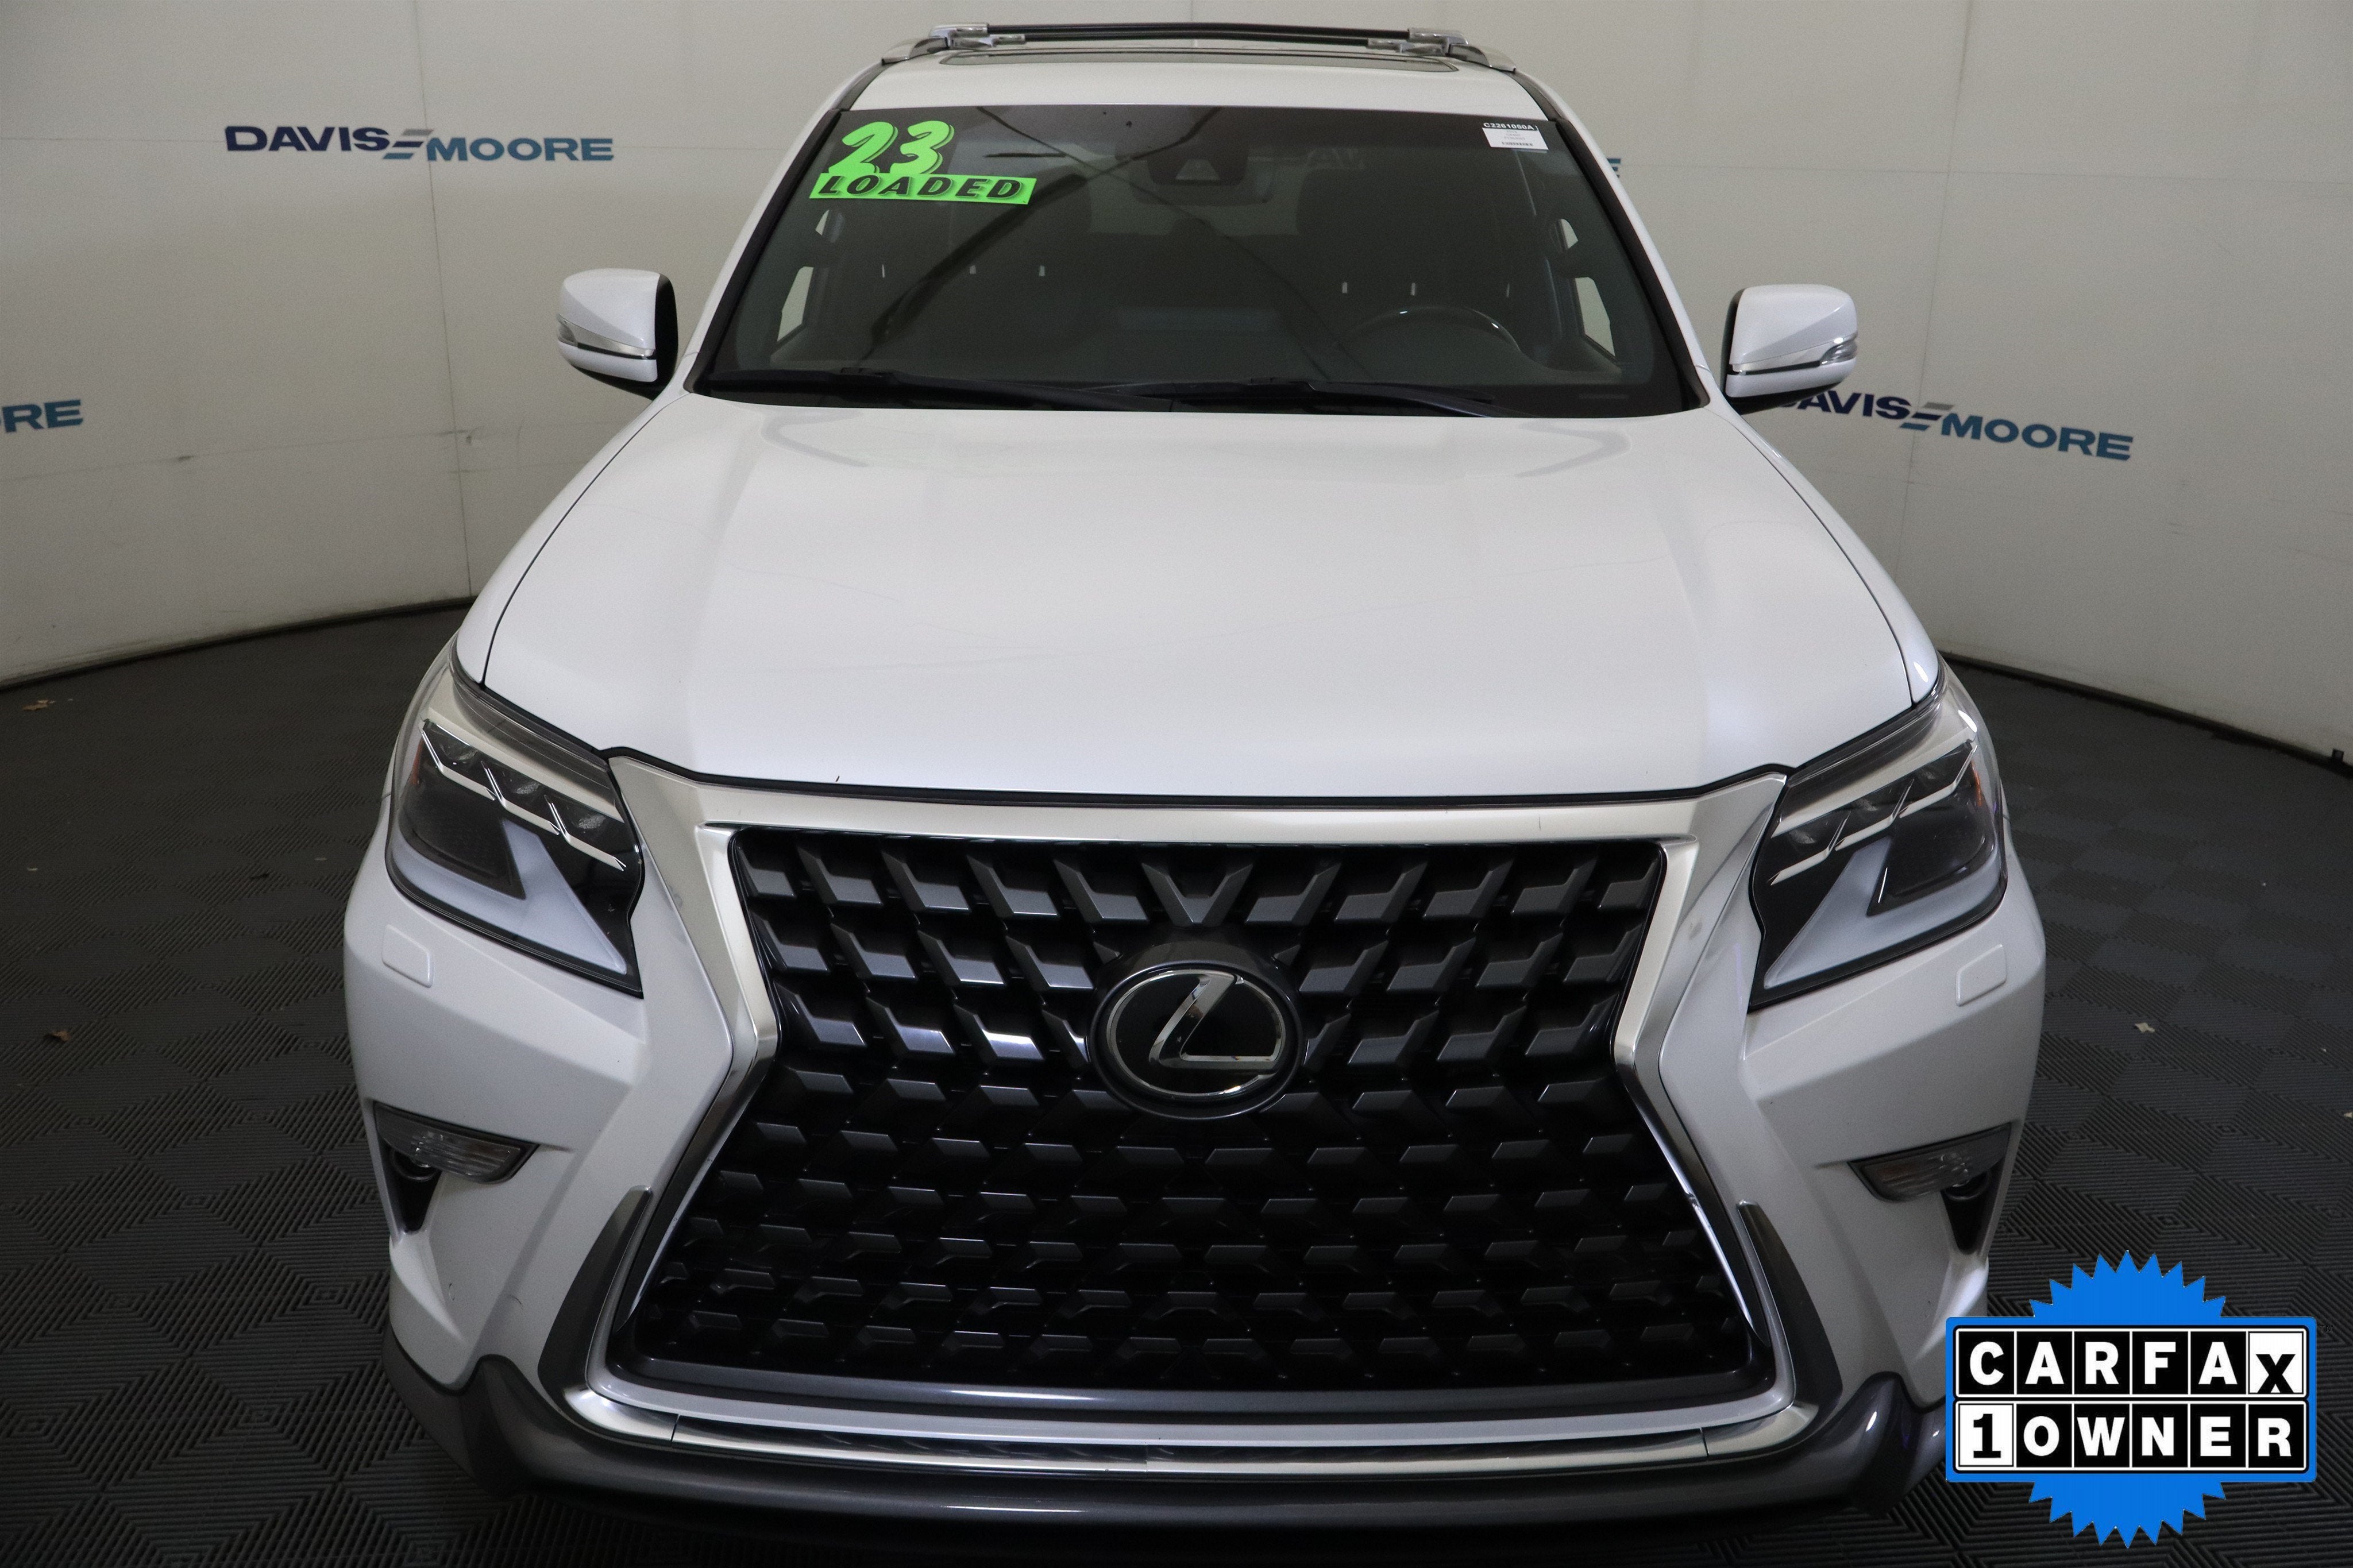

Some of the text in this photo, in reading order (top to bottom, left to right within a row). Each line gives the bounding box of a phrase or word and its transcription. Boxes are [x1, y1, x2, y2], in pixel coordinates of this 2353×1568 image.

[224, 126, 614, 162] DAVIS MOORE
[828, 120, 955, 174] 23
[819, 175, 1024, 200] LOADED
[0, 399, 84, 433] RE
[1780, 390, 2134, 461] AVIS MOORE
